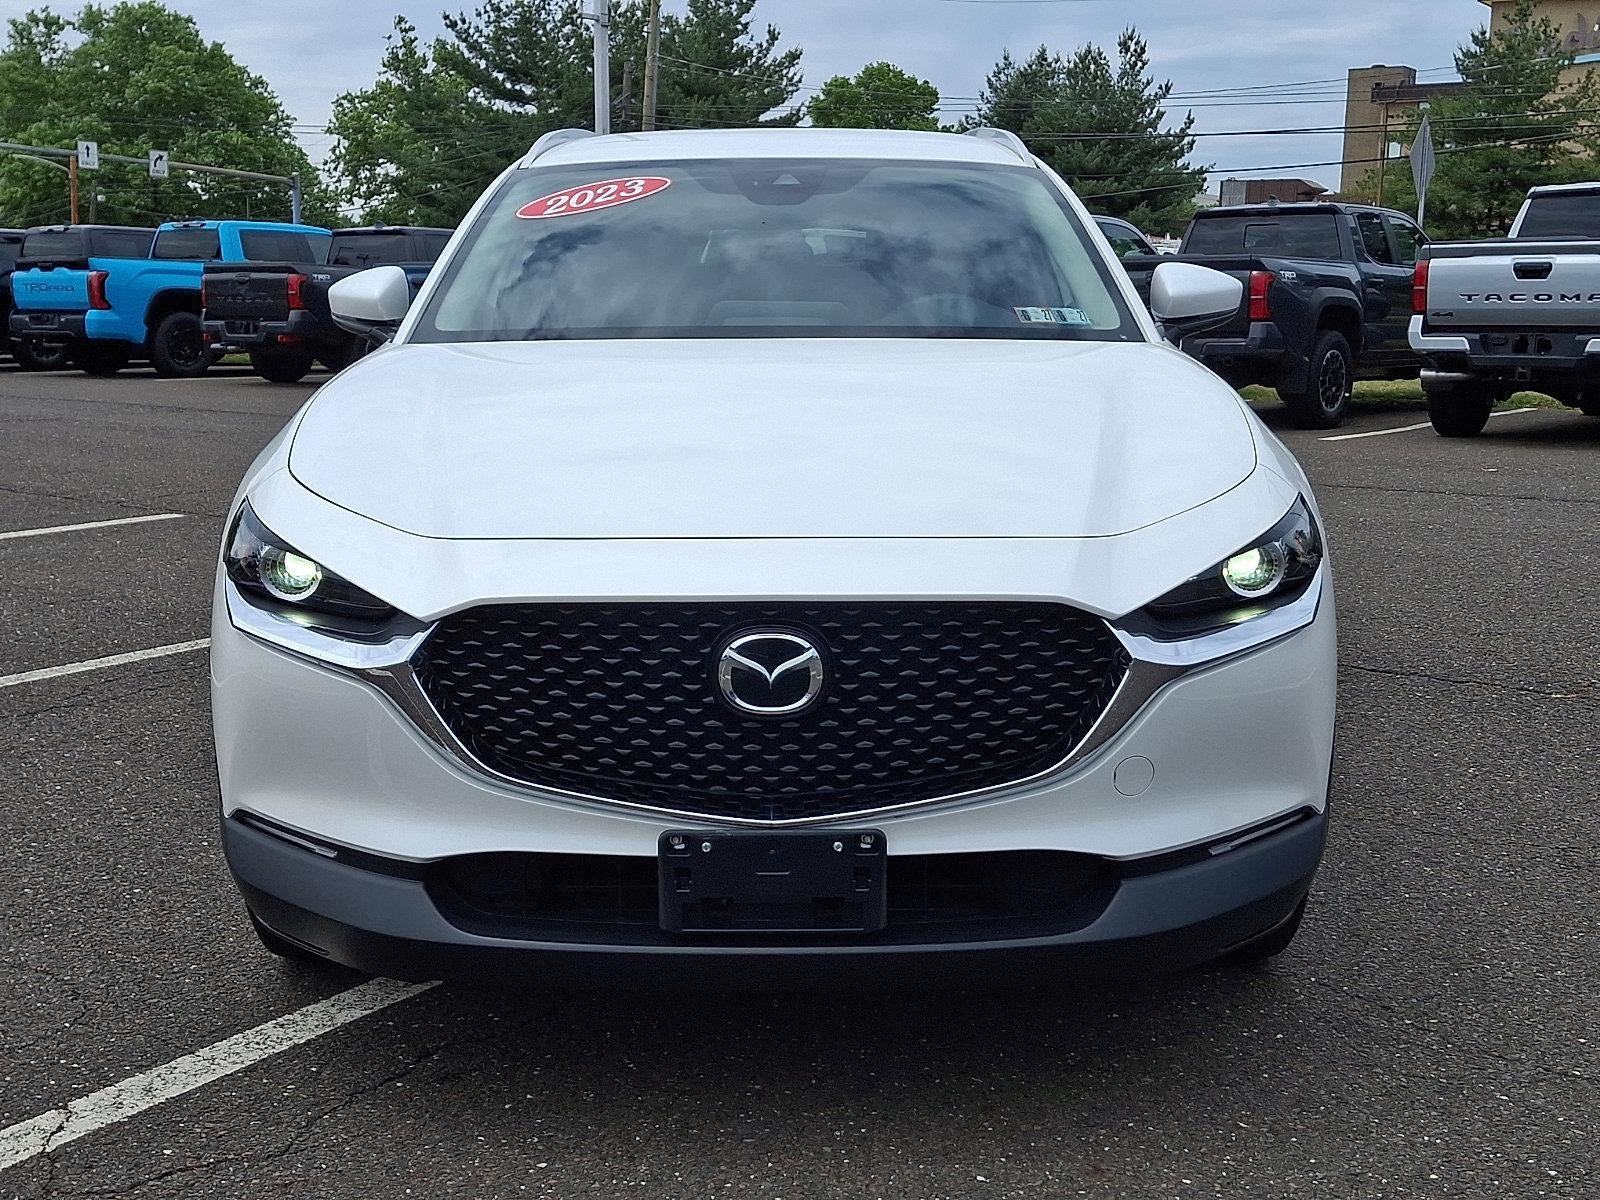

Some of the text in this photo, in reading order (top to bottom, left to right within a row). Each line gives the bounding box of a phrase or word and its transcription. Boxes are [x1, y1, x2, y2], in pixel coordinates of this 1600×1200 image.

[543, 179, 646, 215] 2023
[1280, 271, 1296, 280] TRD
[1459, 293, 1600, 304] TACOMA
